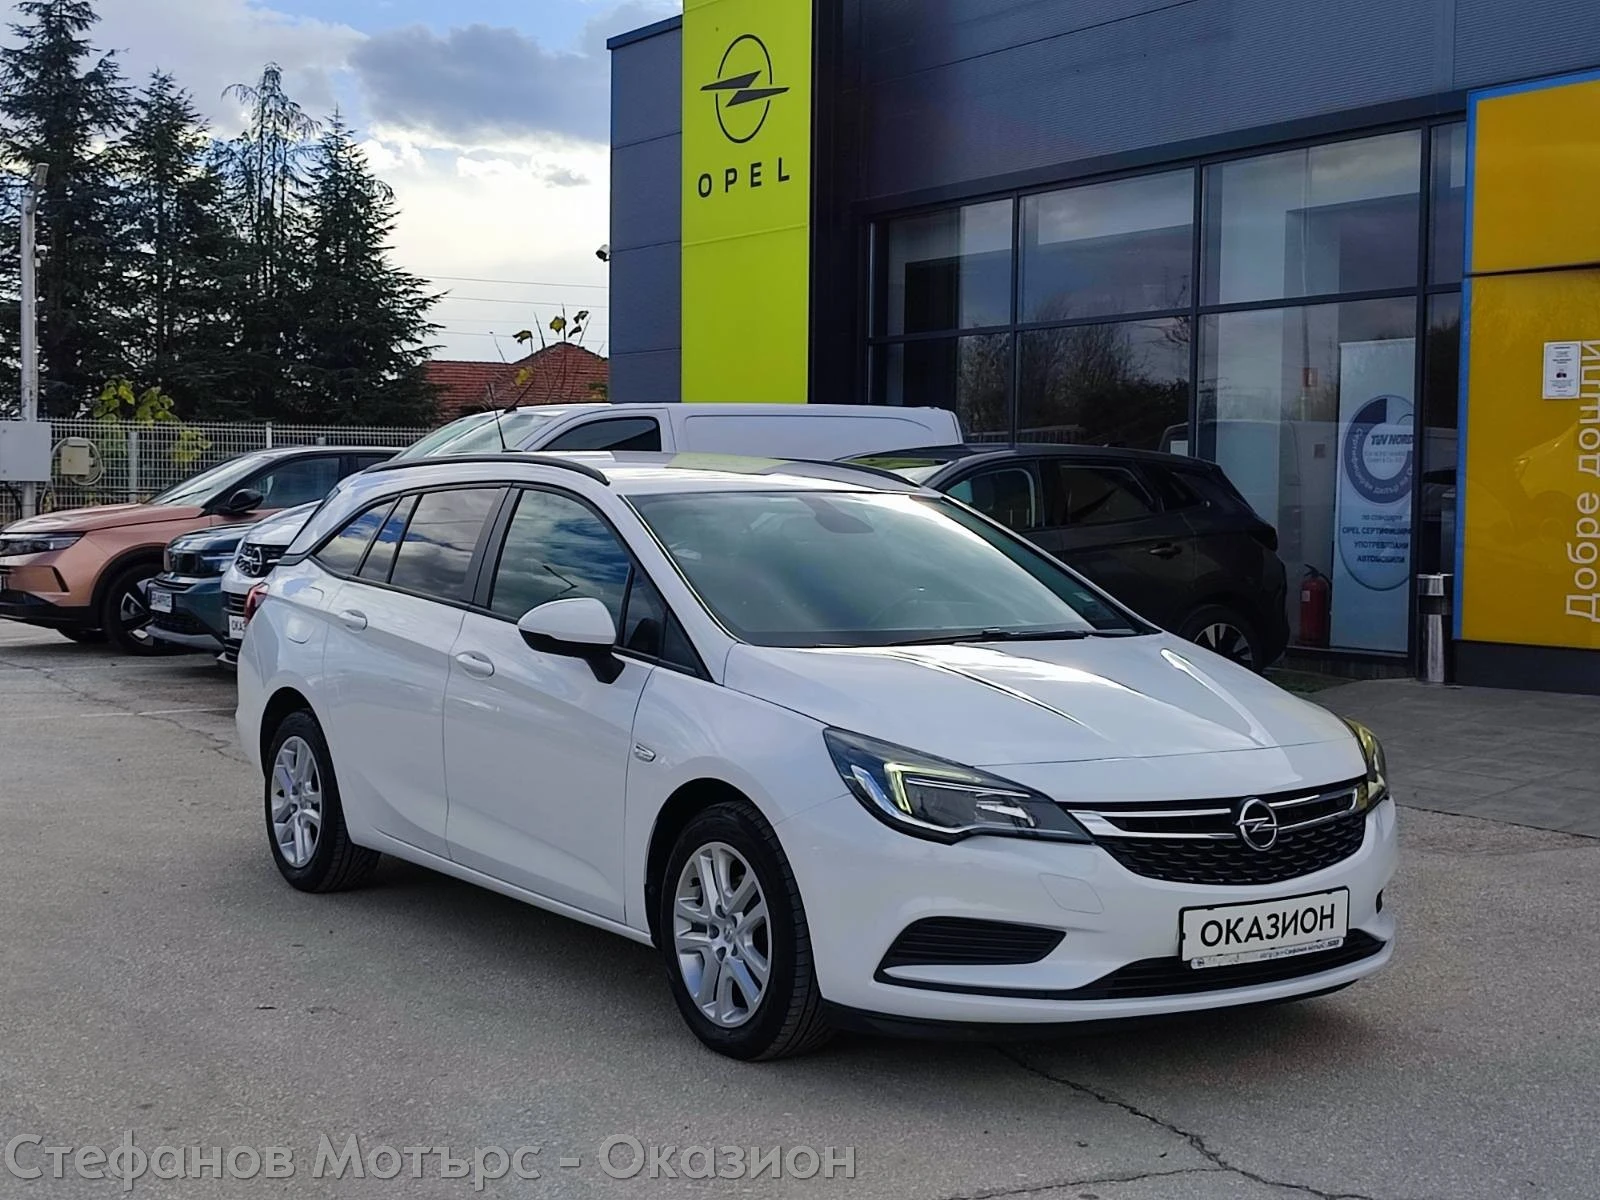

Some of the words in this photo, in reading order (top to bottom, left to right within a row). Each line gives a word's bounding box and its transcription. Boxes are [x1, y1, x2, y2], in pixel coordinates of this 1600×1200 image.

[697, 157, 791, 199] OPEL
[1577, 340, 1600, 478] дошли
[1565, 491, 1600, 623] Добре
[1200, 903, 1335, 947] ОКАЗИОН
